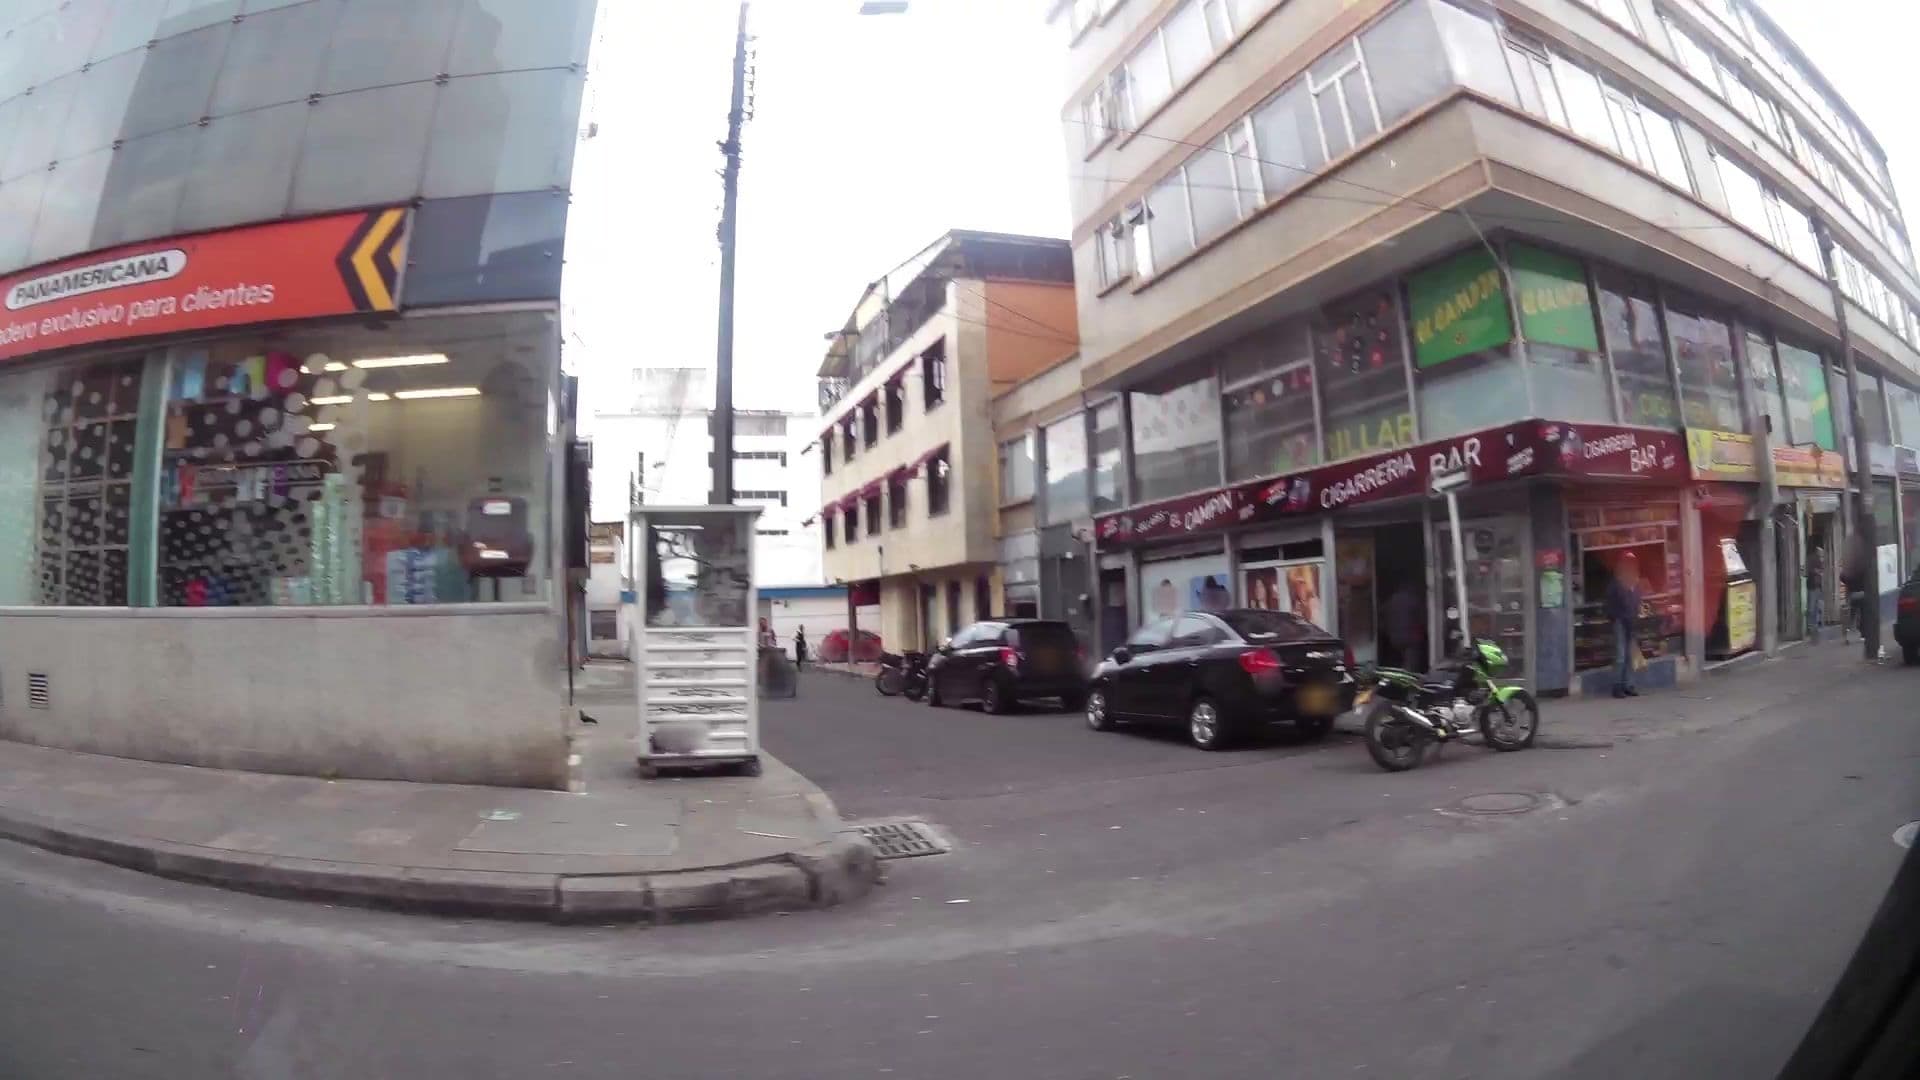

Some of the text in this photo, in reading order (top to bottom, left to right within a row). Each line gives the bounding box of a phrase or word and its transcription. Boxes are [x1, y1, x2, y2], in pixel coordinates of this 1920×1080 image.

[14, 256, 169, 305] PANAMERICANA
[41, 302, 125, 336] exclusivo
[127, 296, 177, 326] para
[181, 283, 275, 313] clientes
[1320, 452, 1416, 509] CIGARRERIA
[1429, 437, 1481, 477] BAR
[1630, 444, 1658, 473] BAR
